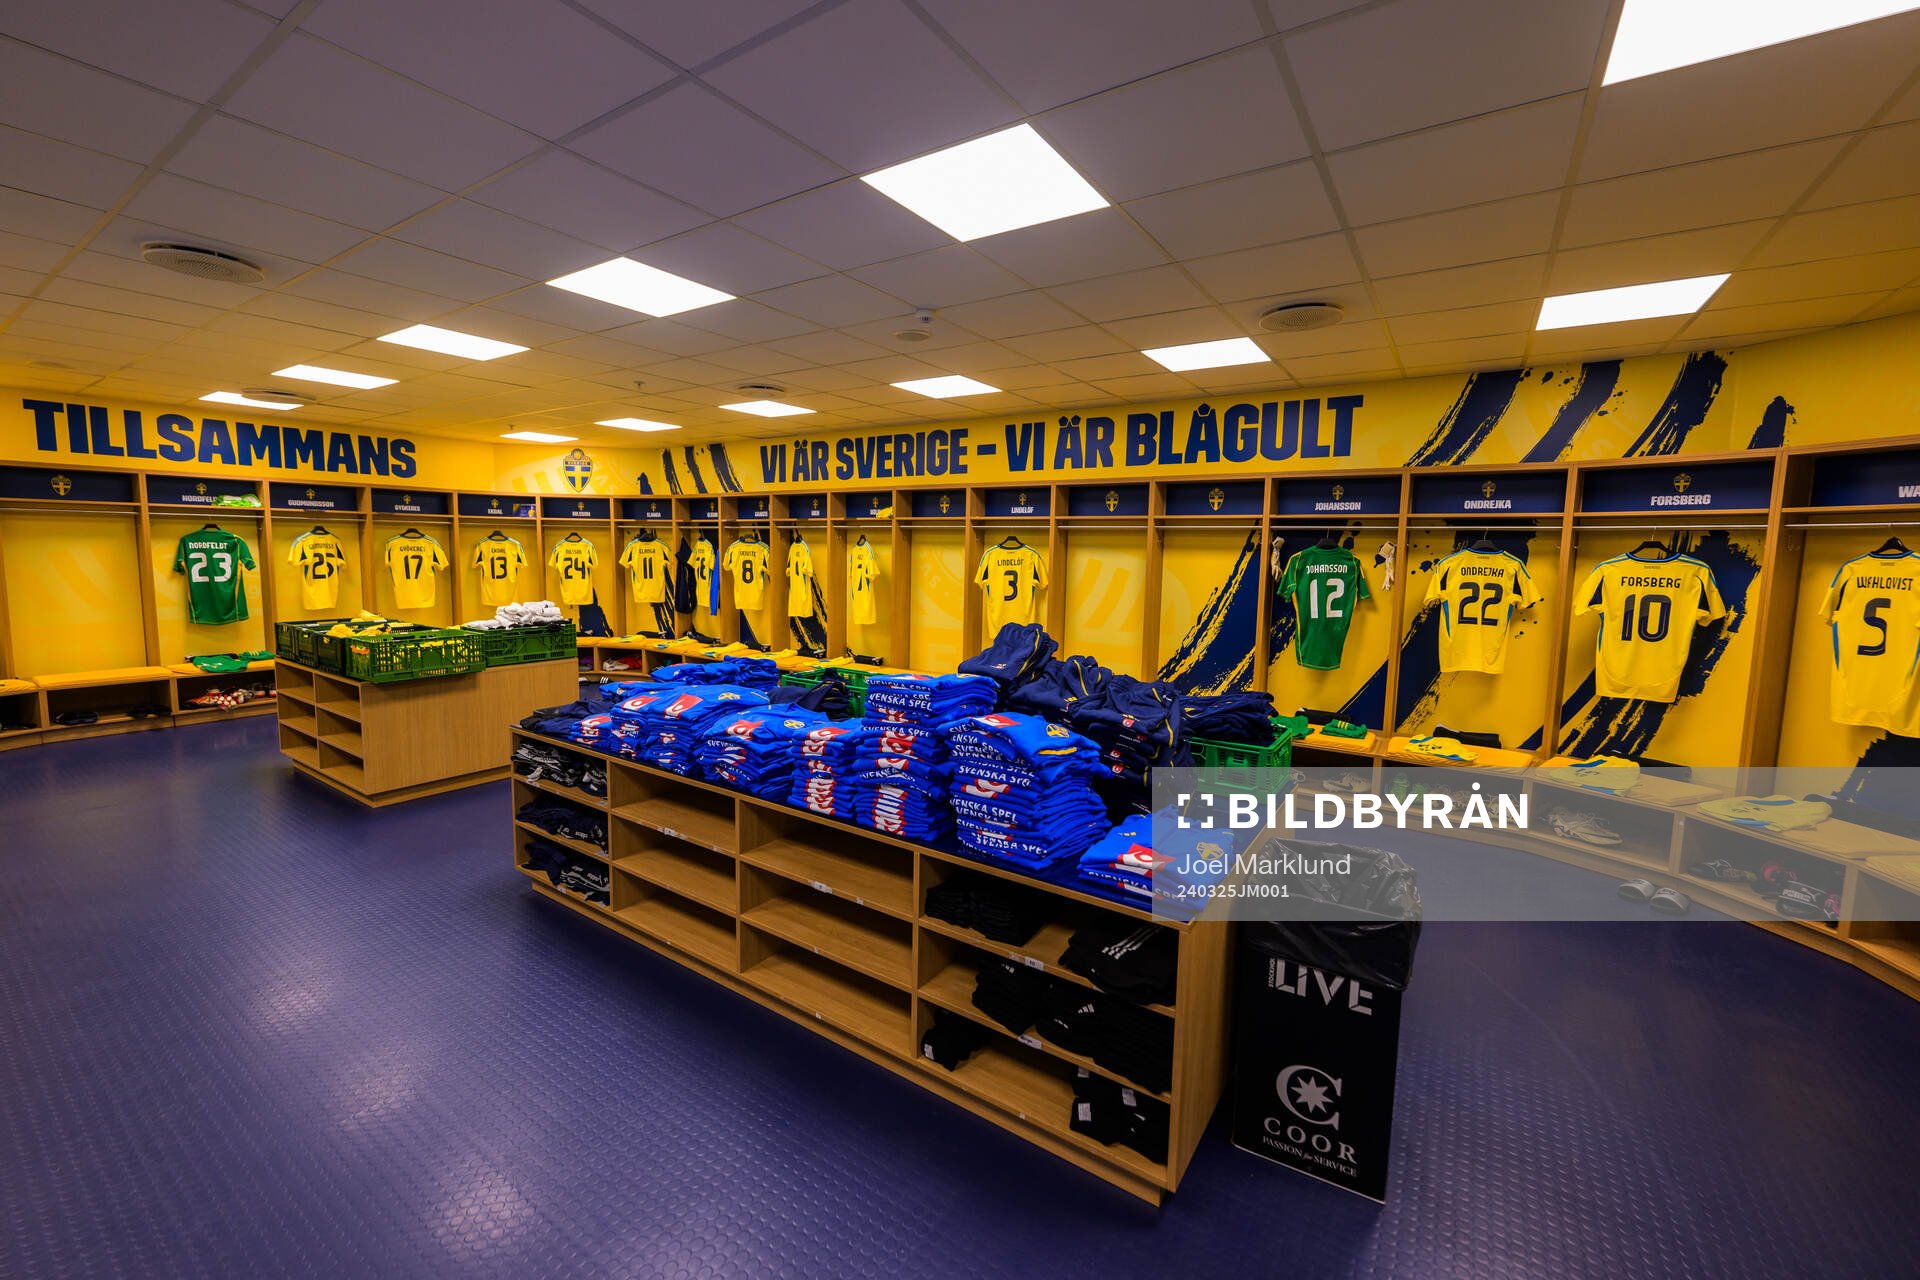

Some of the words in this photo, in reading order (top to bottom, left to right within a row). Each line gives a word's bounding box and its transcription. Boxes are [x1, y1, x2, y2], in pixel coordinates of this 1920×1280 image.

[22, 398, 418, 478] TILLSAMMANS
[760, 443, 786, 483] VI
[792, 439, 829, 482] ÄR
[836, 428, 969, 481] SVERIGE
[1005, 422, 1046, 472] VI
[1053, 414, 1115, 470] ÄR
[1125, 394, 1364, 467] BLÅGULT
[1315, 502, 1361, 511] JOHANSSON
[1464, 500, 1511, 509] ONDREJKA
[1650, 494, 1711, 506] FORSBERG
[188, 541, 228, 550] NORDFELDT
[188, 552, 232, 583] 23
[403, 555, 424, 580] 17
[490, 556, 508, 580] 13
[563, 557, 586, 580] 24
[642, 557, 654, 579] 11
[742, 560, 754, 584] 8
[1306, 564, 1348, 574] JOHANSSON
[1461, 566, 1505, 578] ONDREJKA
[1003, 570, 1019, 601] 3
[1620, 576, 1682, 589] FORSBERG
[1309, 578, 1345, 619] 12
[1457, 581, 1504, 627] 22
[1621, 594, 1672, 643] 10
[1857, 597, 1892, 656] 5
[908, 699, 933, 712] SPEL
[958, 765, 1007, 782] SVENSKA
[991, 807, 1019, 824] SPEL
[1275, 959, 1373, 1016] LIVE
[1263, 1117, 1357, 1165] COOR
[1262, 1135, 1303, 1158] PASSION
[1313, 1154, 1357, 1177] SERVICE
